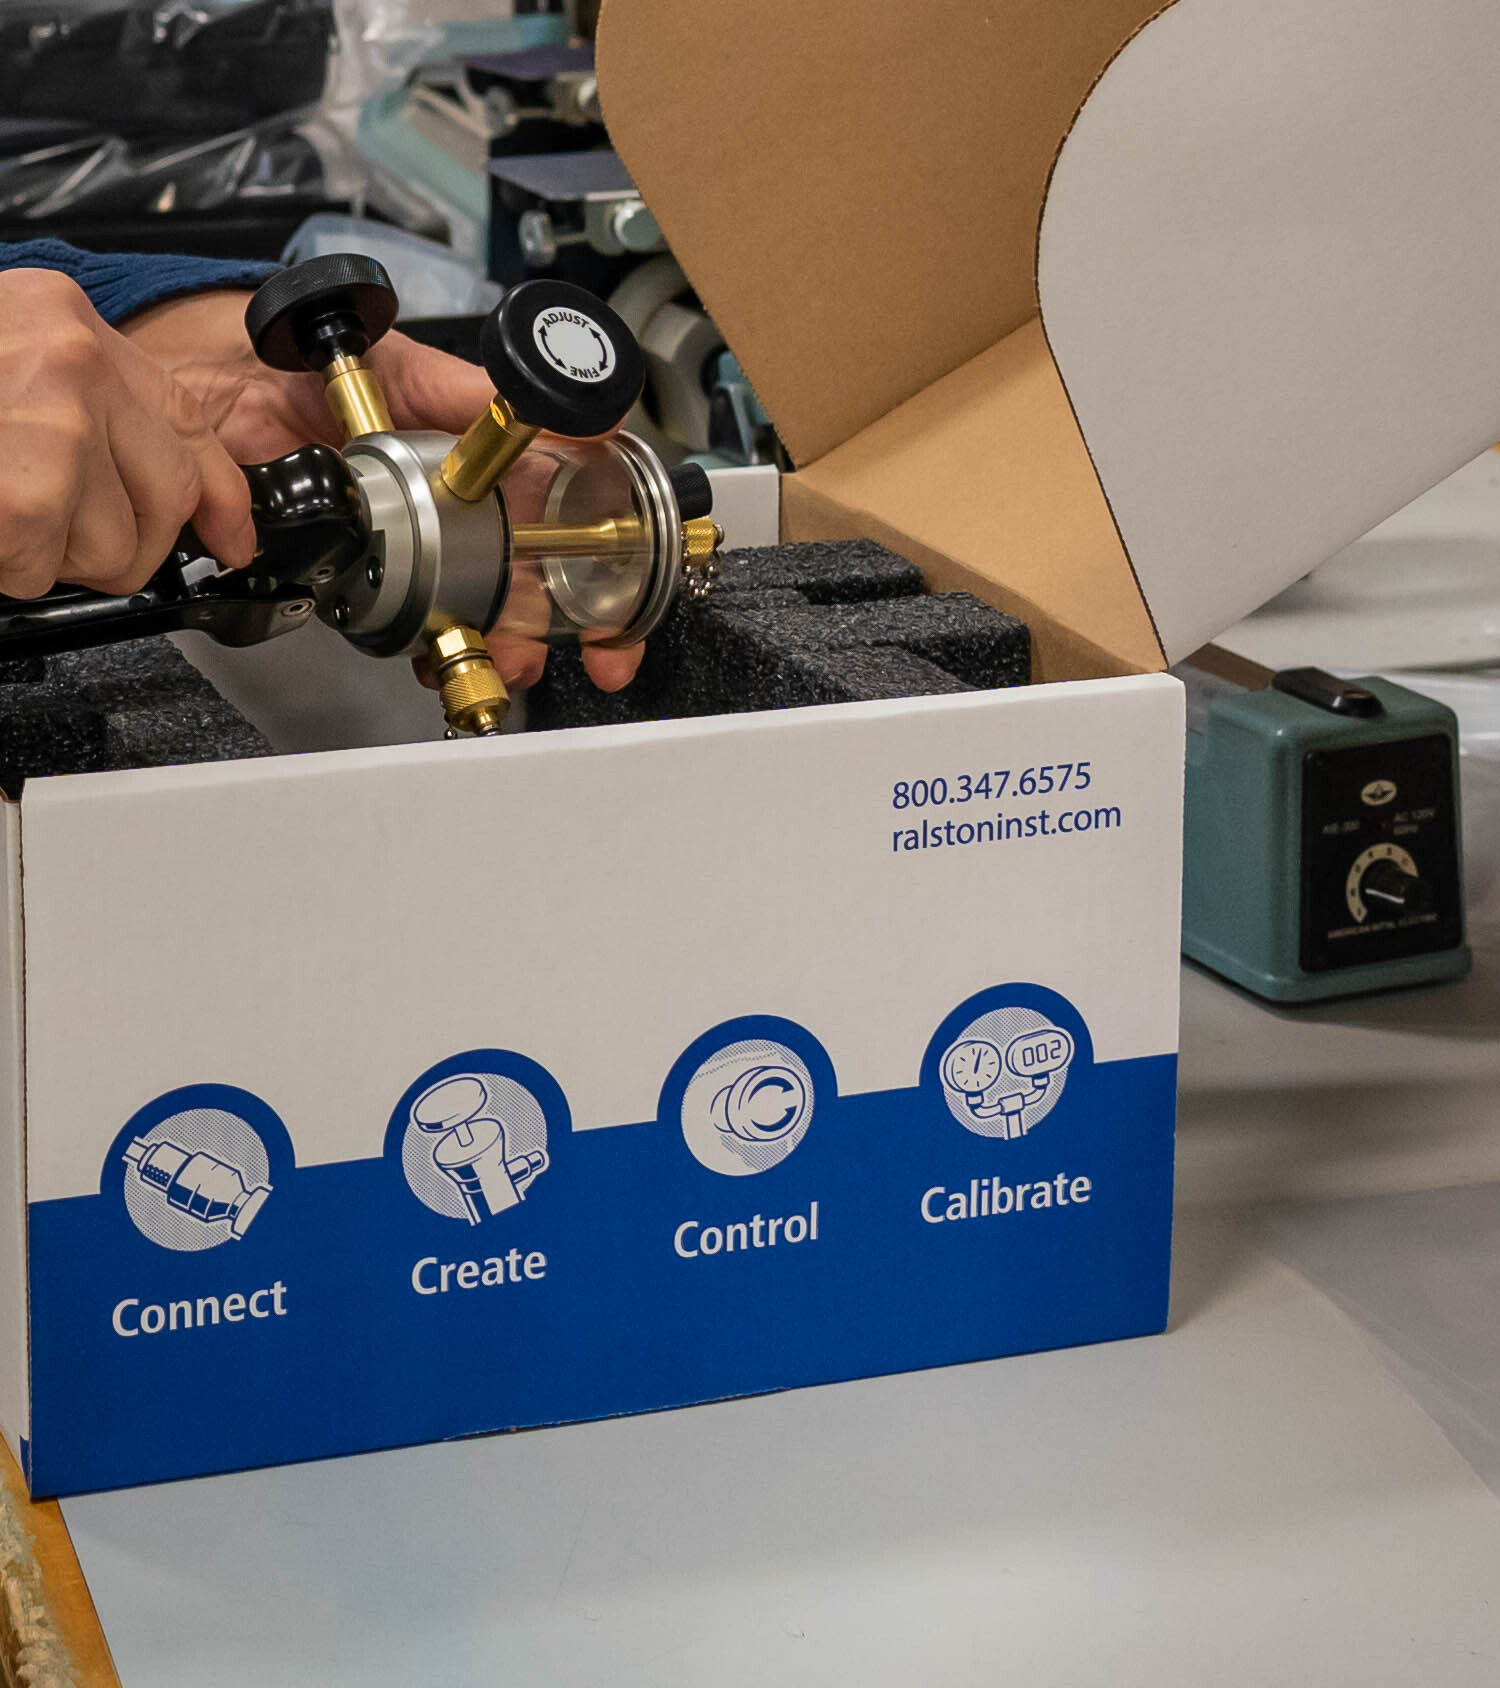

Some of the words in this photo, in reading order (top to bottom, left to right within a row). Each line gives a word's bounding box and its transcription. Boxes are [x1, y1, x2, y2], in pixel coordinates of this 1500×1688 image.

[542, 311, 590, 328] ADJUST
[570, 365, 600, 379] FINE
[892, 761, 1091, 810] 800.347.6575
[892, 805, 1122, 852] ralstoninst.com
[920, 1172, 1092, 1224] Calibrate
[673, 1201, 820, 1259] Control
[411, 1247, 548, 1296] Create
[111, 1280, 288, 1338] Connect
